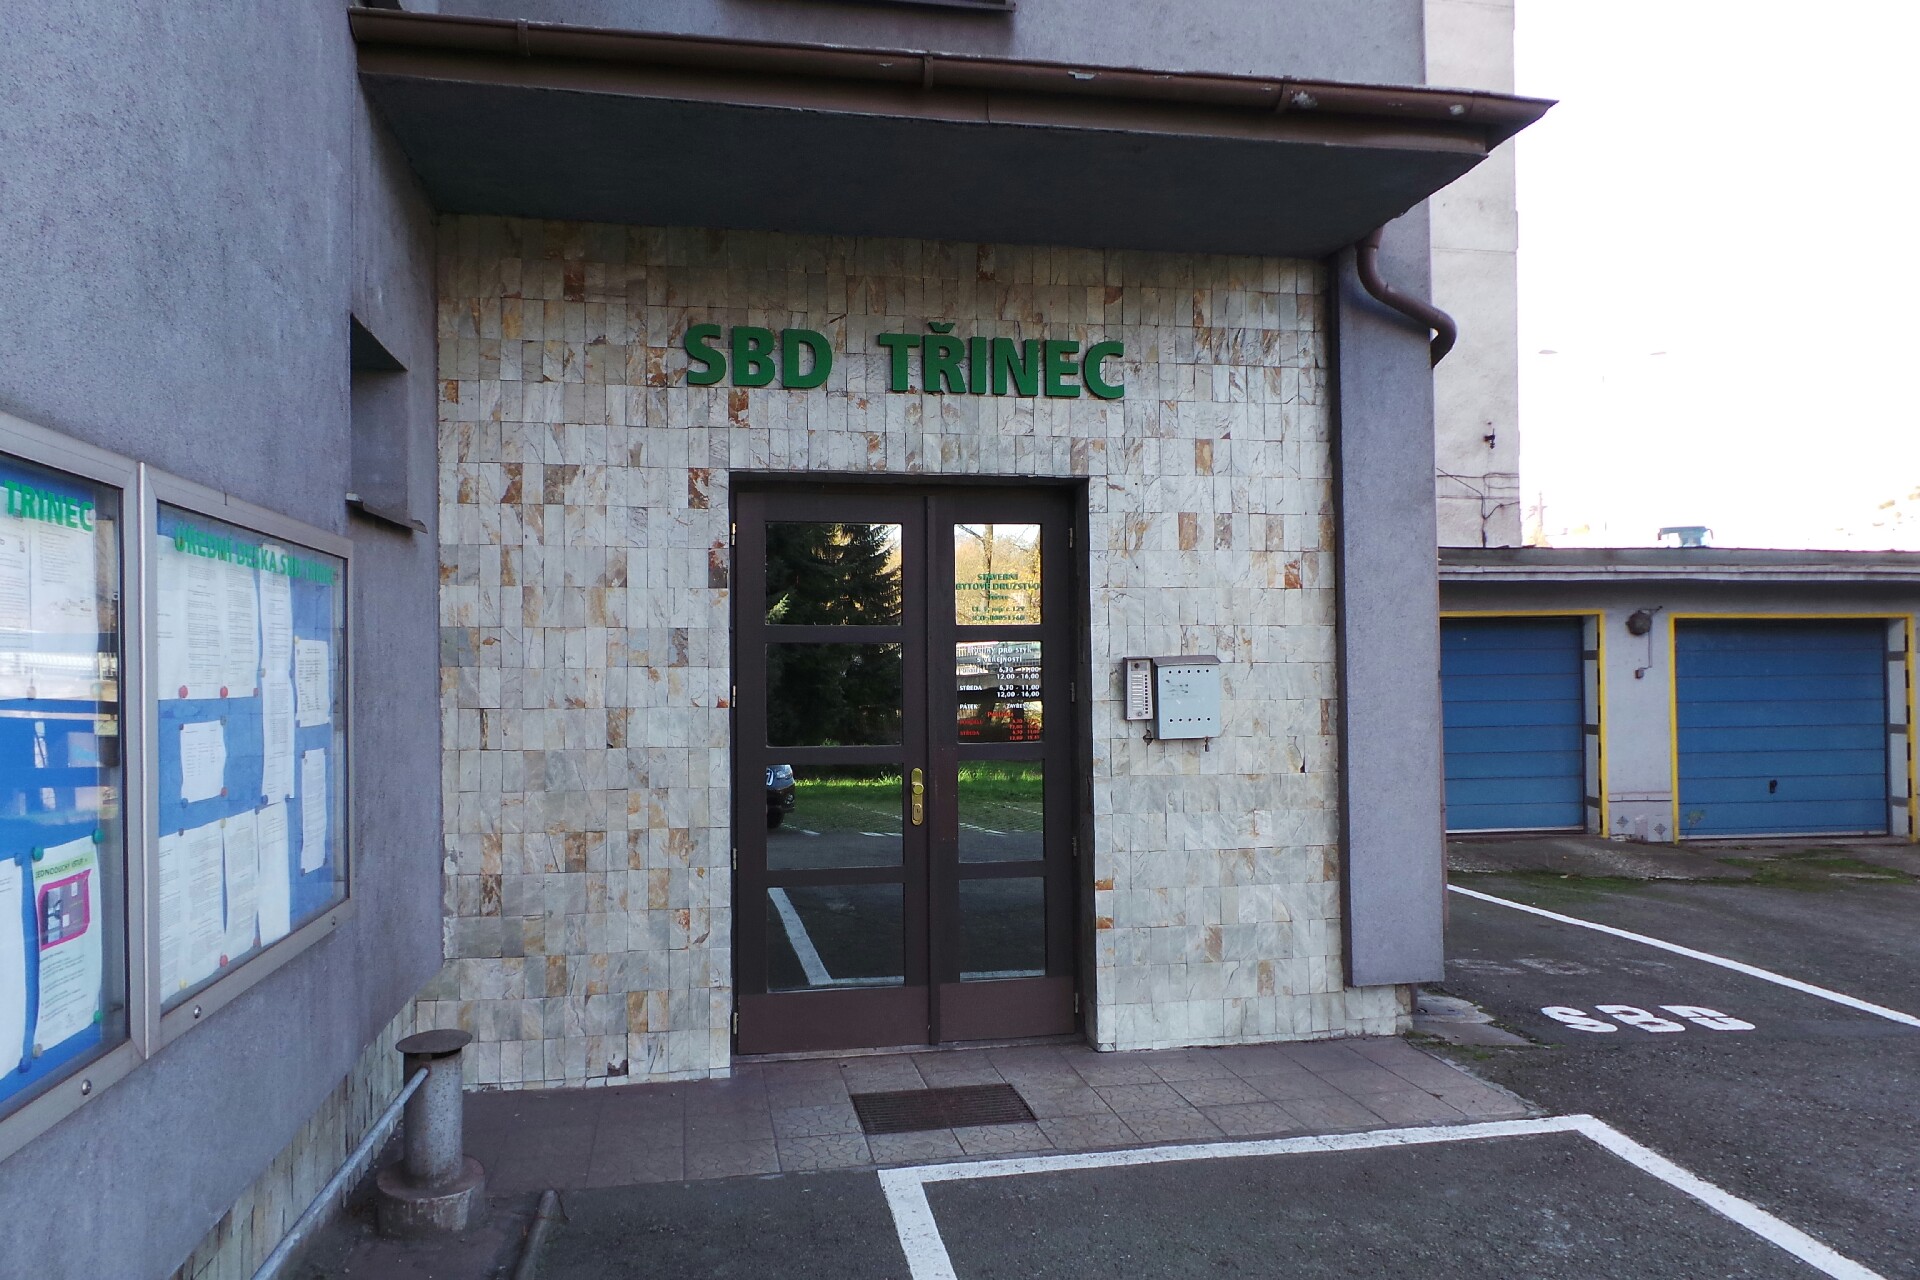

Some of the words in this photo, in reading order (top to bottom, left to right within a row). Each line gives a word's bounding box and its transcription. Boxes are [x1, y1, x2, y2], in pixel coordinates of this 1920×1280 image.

[684, 323, 833, 389] SBD
[878, 321, 1125, 399] TŘINEC
[1021, 691, 1040, 699] 16,00
[1541, 1005, 1755, 1032] SBD
